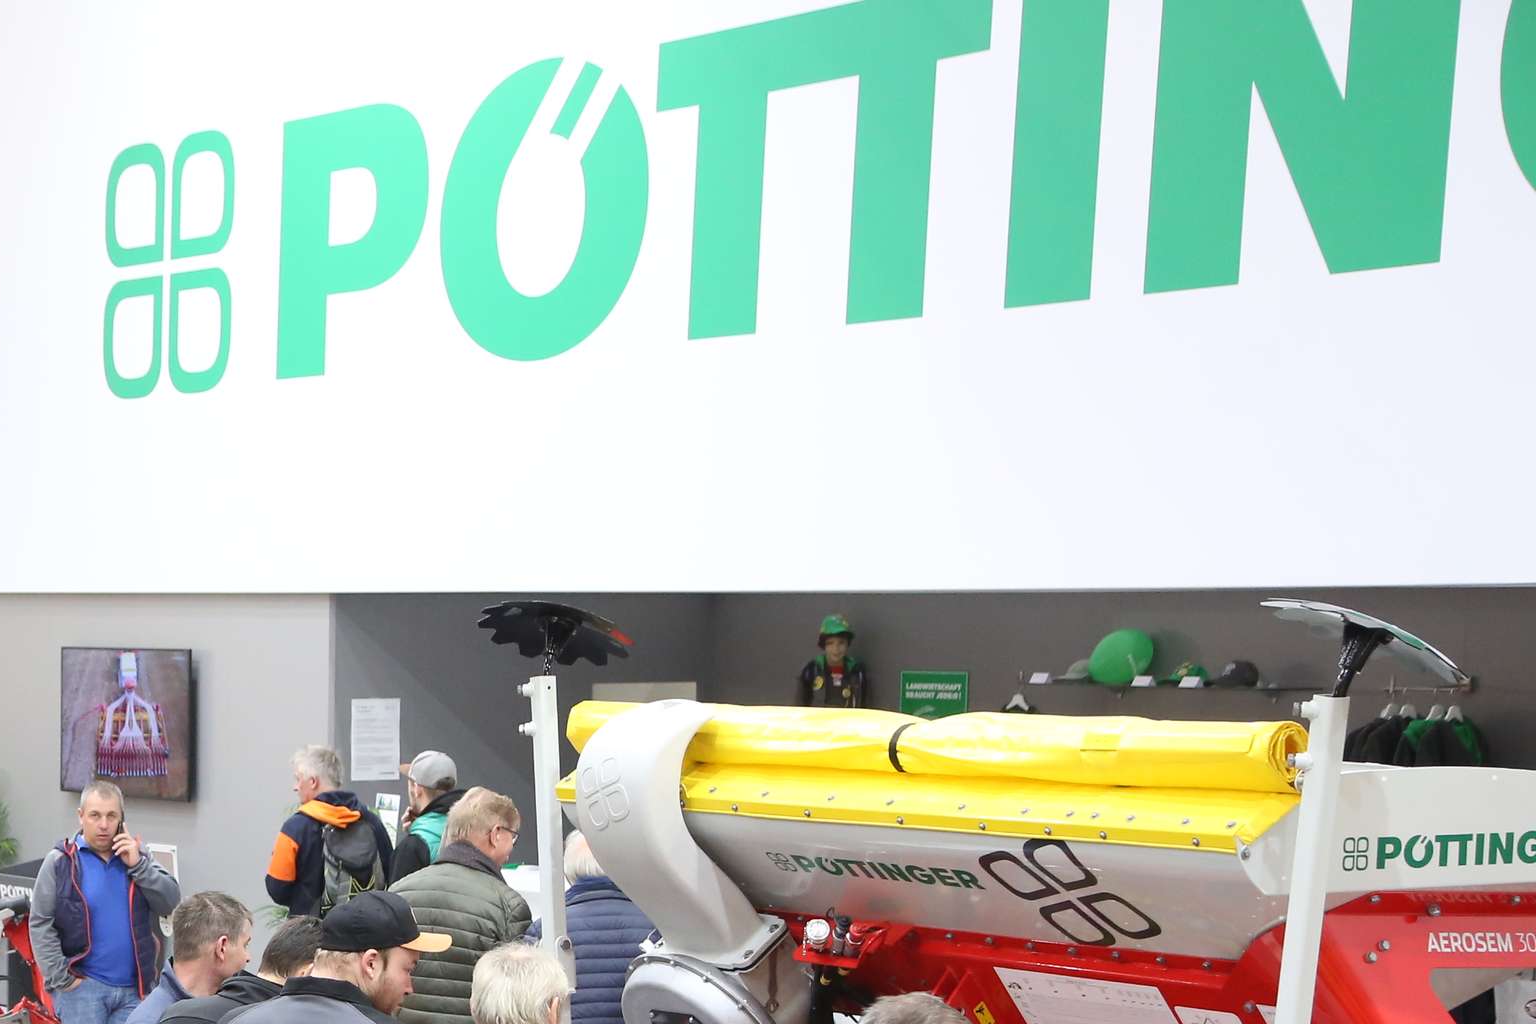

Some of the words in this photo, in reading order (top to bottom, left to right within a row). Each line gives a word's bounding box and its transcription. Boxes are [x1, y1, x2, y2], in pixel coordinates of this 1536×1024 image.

[276, 0, 1536, 380] PÖTTIN
[790, 853, 987, 890] PÖTTINGER
[1427, 931, 1514, 953] AEROSEM
